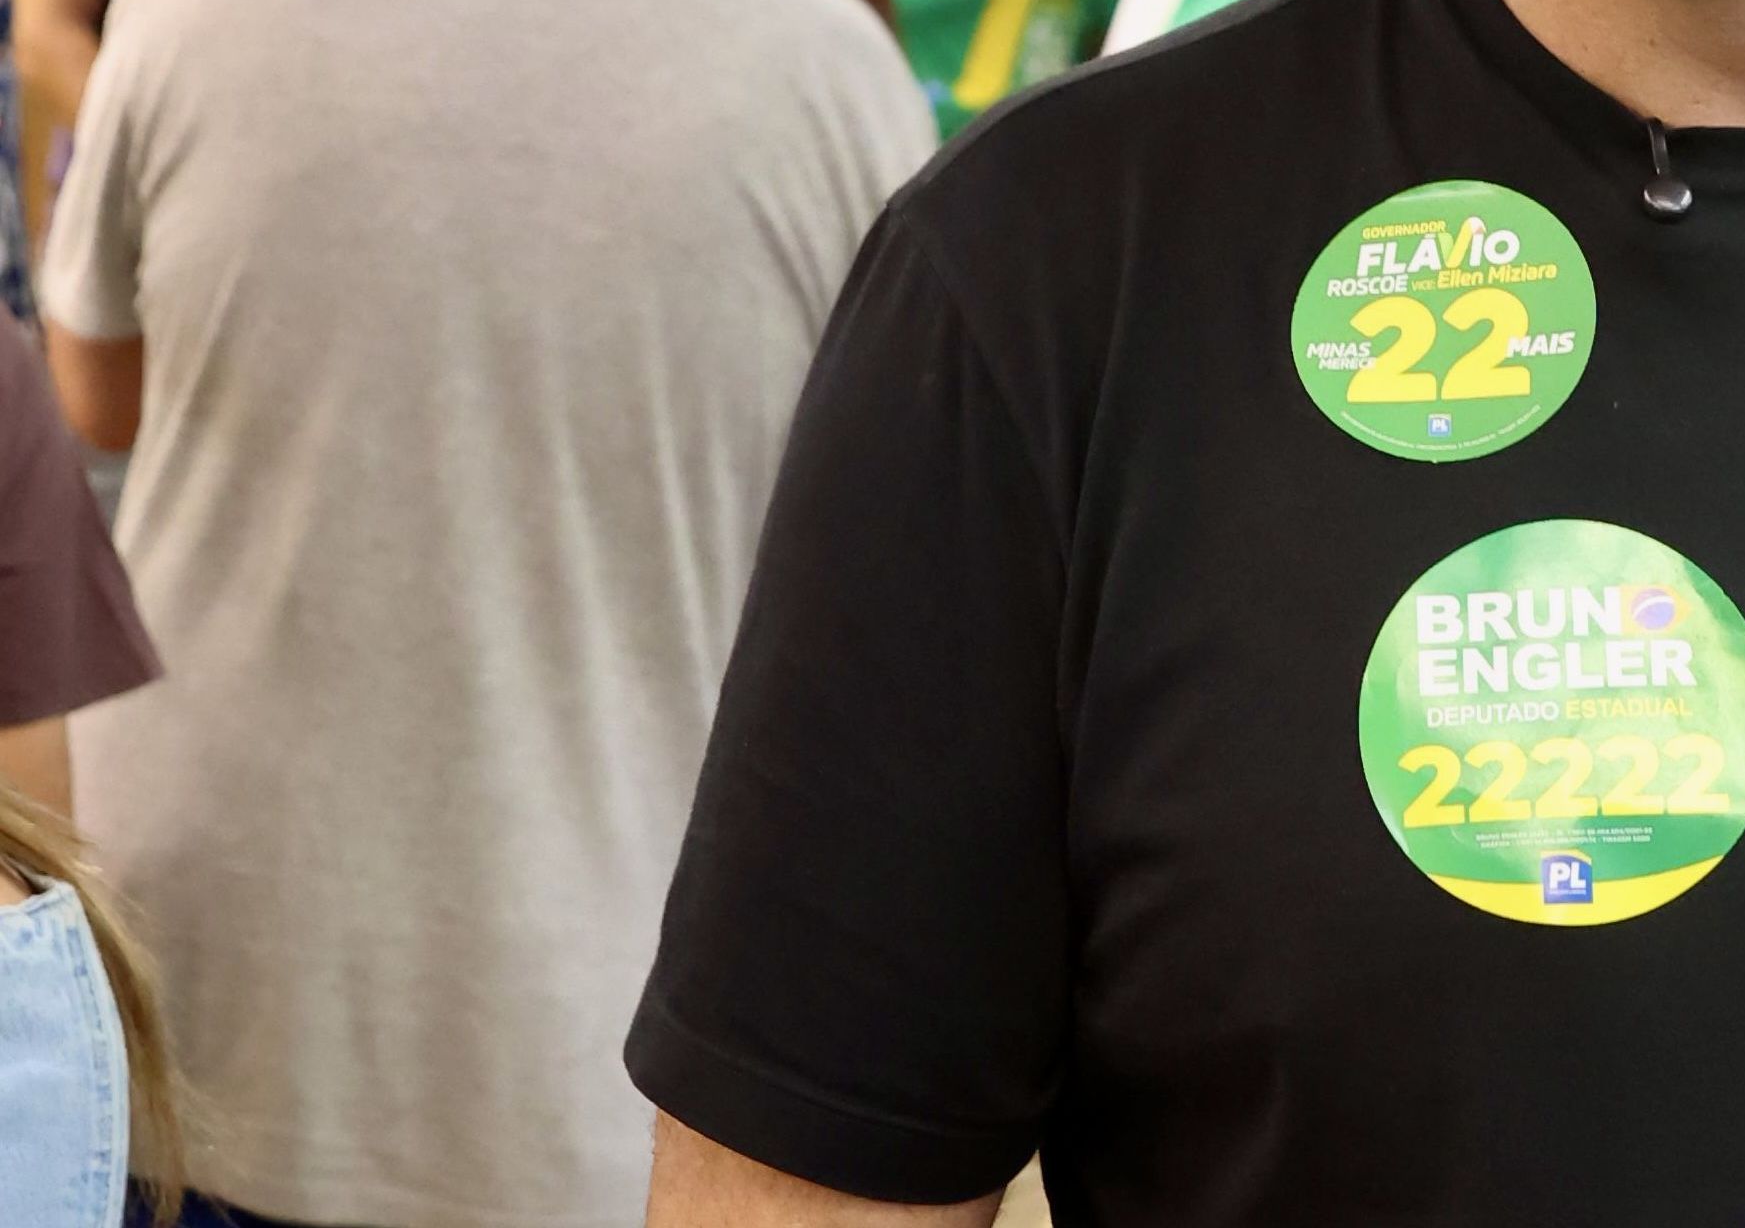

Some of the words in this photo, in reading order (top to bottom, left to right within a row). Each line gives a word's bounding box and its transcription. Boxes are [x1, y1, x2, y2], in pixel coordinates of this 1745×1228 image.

[1362, 221, 1447, 239] GOVERNADOR
[1356, 216, 1520, 277] FLÁVIO
[1327, 275, 1409, 297] ROSCOE
[1306, 342, 1372, 359] MINAS
[1346, 287, 1531, 404] 22
[1505, 331, 1576, 358] MAIS
[1417, 638, 1698, 697] ENGLER
[1426, 700, 1560, 728] DEPUTADO
[1565, 697, 1694, 720] ESTADUAL
[1398, 733, 1730, 828] 22222
[1550, 861, 1587, 889] PL
